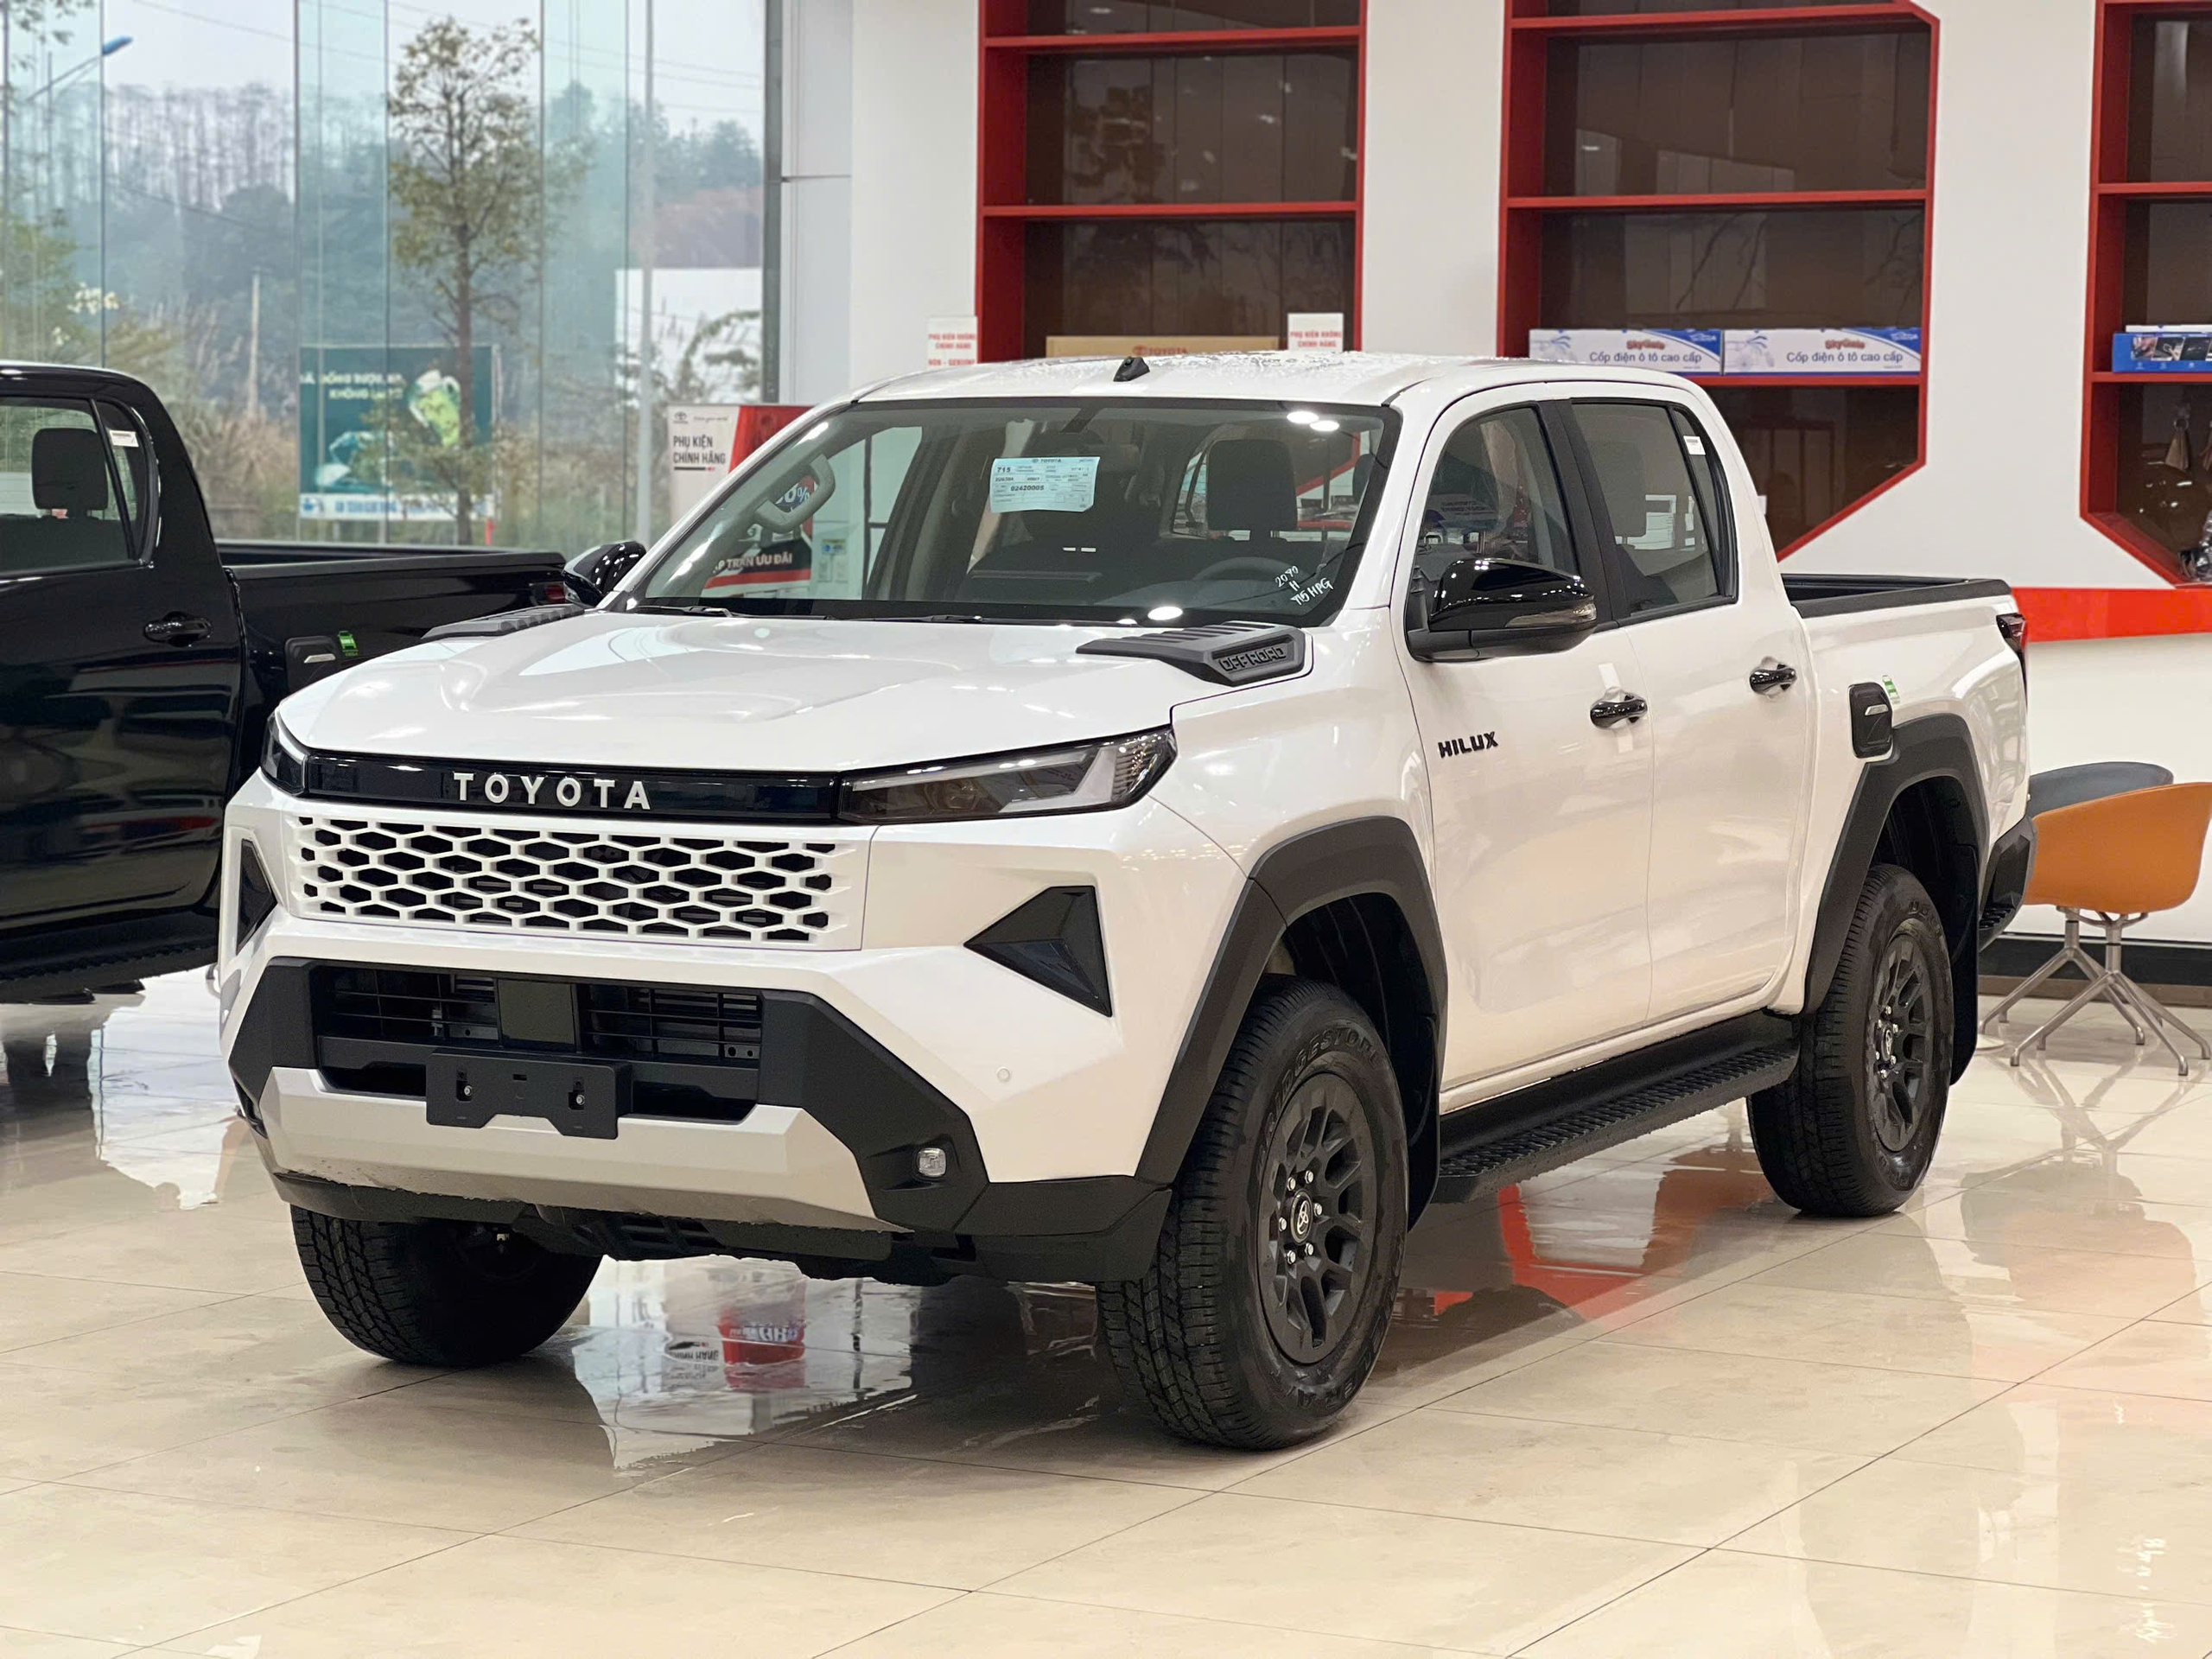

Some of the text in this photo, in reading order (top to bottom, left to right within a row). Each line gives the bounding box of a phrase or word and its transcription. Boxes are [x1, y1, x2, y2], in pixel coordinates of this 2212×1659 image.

[1589, 351, 1611, 365] Cốp
[1613, 352, 1636, 363] điện
[1648, 353, 1658, 362] tô
[1682, 350, 1702, 365] cấp
[1786, 351, 1808, 364] Cốp
[1811, 352, 1834, 363] điện
[1847, 353, 1858, 362] tô
[1883, 350, 1904, 364] cấp
[673, 434, 713, 449] PHỤ KIỆN
[673, 451, 700, 465] CHÍNH
[1218, 647, 1287, 671] OFFROAD
[1437, 731, 1499, 759] HILUX
[453, 772, 651, 810] TOYOTA
